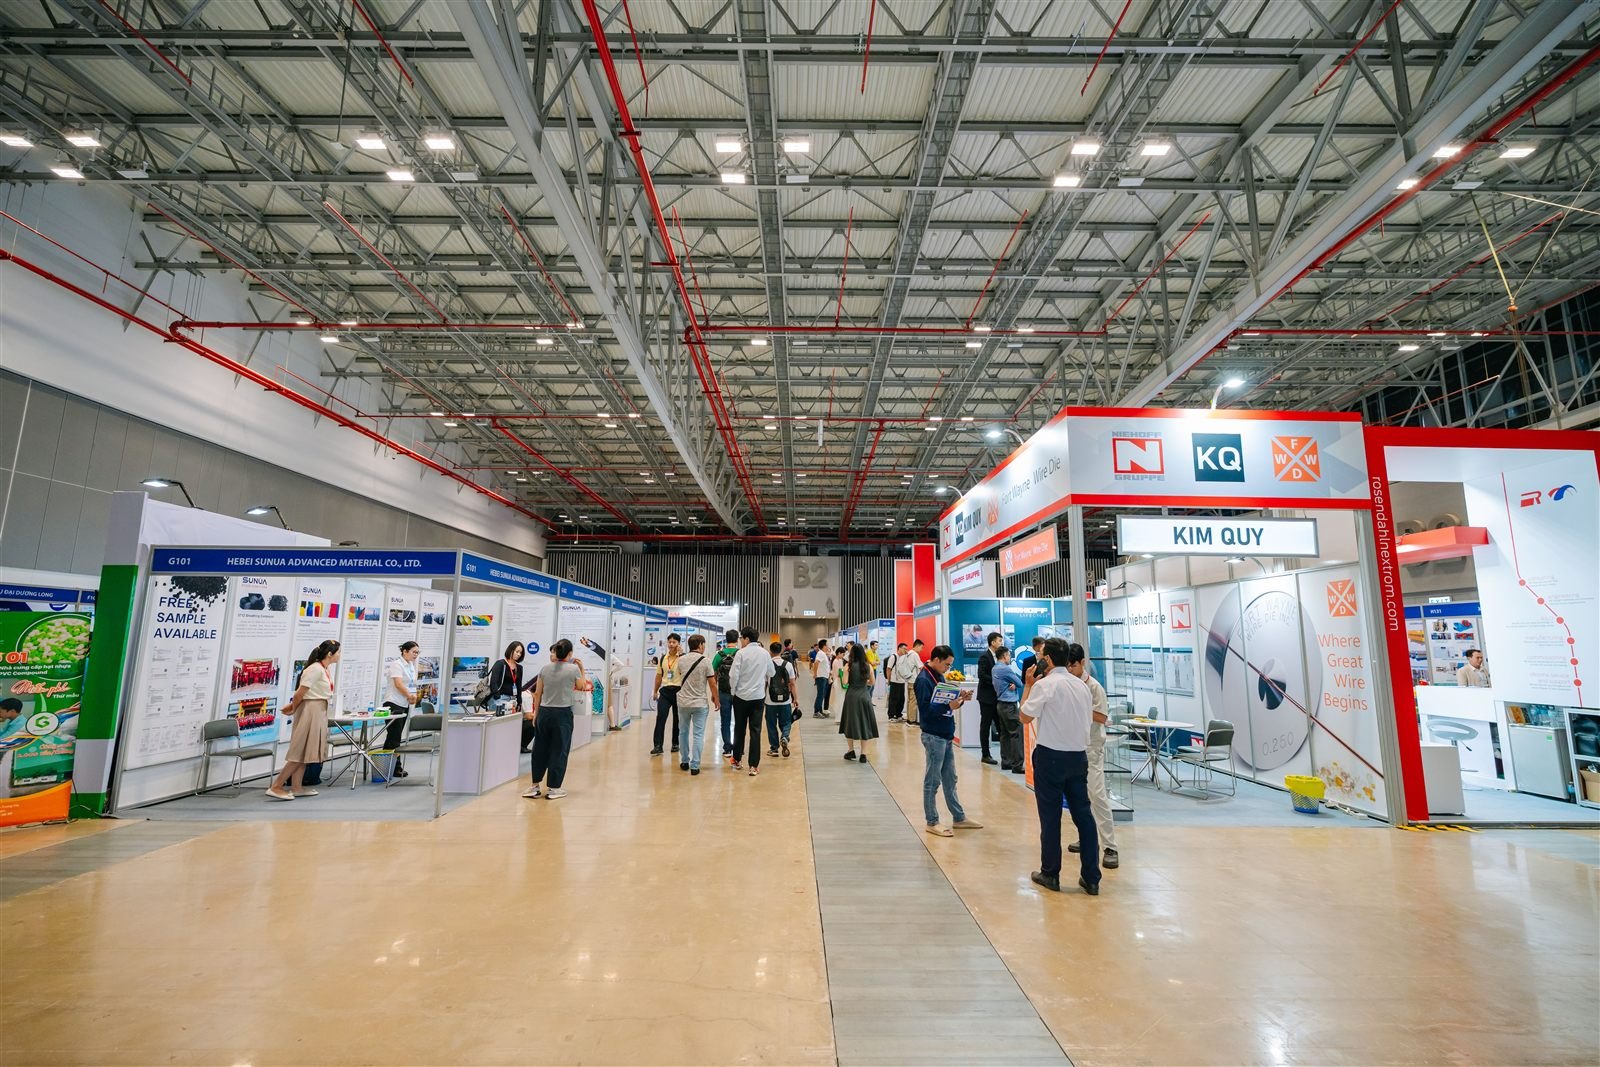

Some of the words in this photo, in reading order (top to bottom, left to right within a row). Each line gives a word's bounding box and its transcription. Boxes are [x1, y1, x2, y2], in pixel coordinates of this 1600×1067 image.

[1290, 438, 1298, 450] F
[1196, 446, 1242, 472] KQ
[1002, 490, 1012, 504] Fort
[1012, 479, 1030, 498] Wayne
[1033, 467, 1048, 485] Wire
[1049, 457, 1060, 475] Die
[1292, 468, 1302, 479] D
[1173, 526, 1212, 545] KIM
[1221, 527, 1264, 546] QUY
[1372, 476, 1399, 631] rosendahlnextrom.com
[288, 558, 337, 567] ADVANCED
[339, 559, 383, 567] MATERIAL
[385, 559, 402, 568] CO.,
[404, 559, 422, 568] LTD.
[466, 564, 476, 572] G101
[793, 560, 828, 589] B2
[160, 597, 194, 609] FREE
[157, 612, 206, 624] SAMPLE
[154, 628, 216, 639] AVAILABLE
[1318, 634, 1360, 648] Where
[6, 651, 28, 664] 01
[1327, 653, 1364, 668] Great
[1334, 674, 1365, 689] Wire
[1324, 692, 1368, 712] Begins
